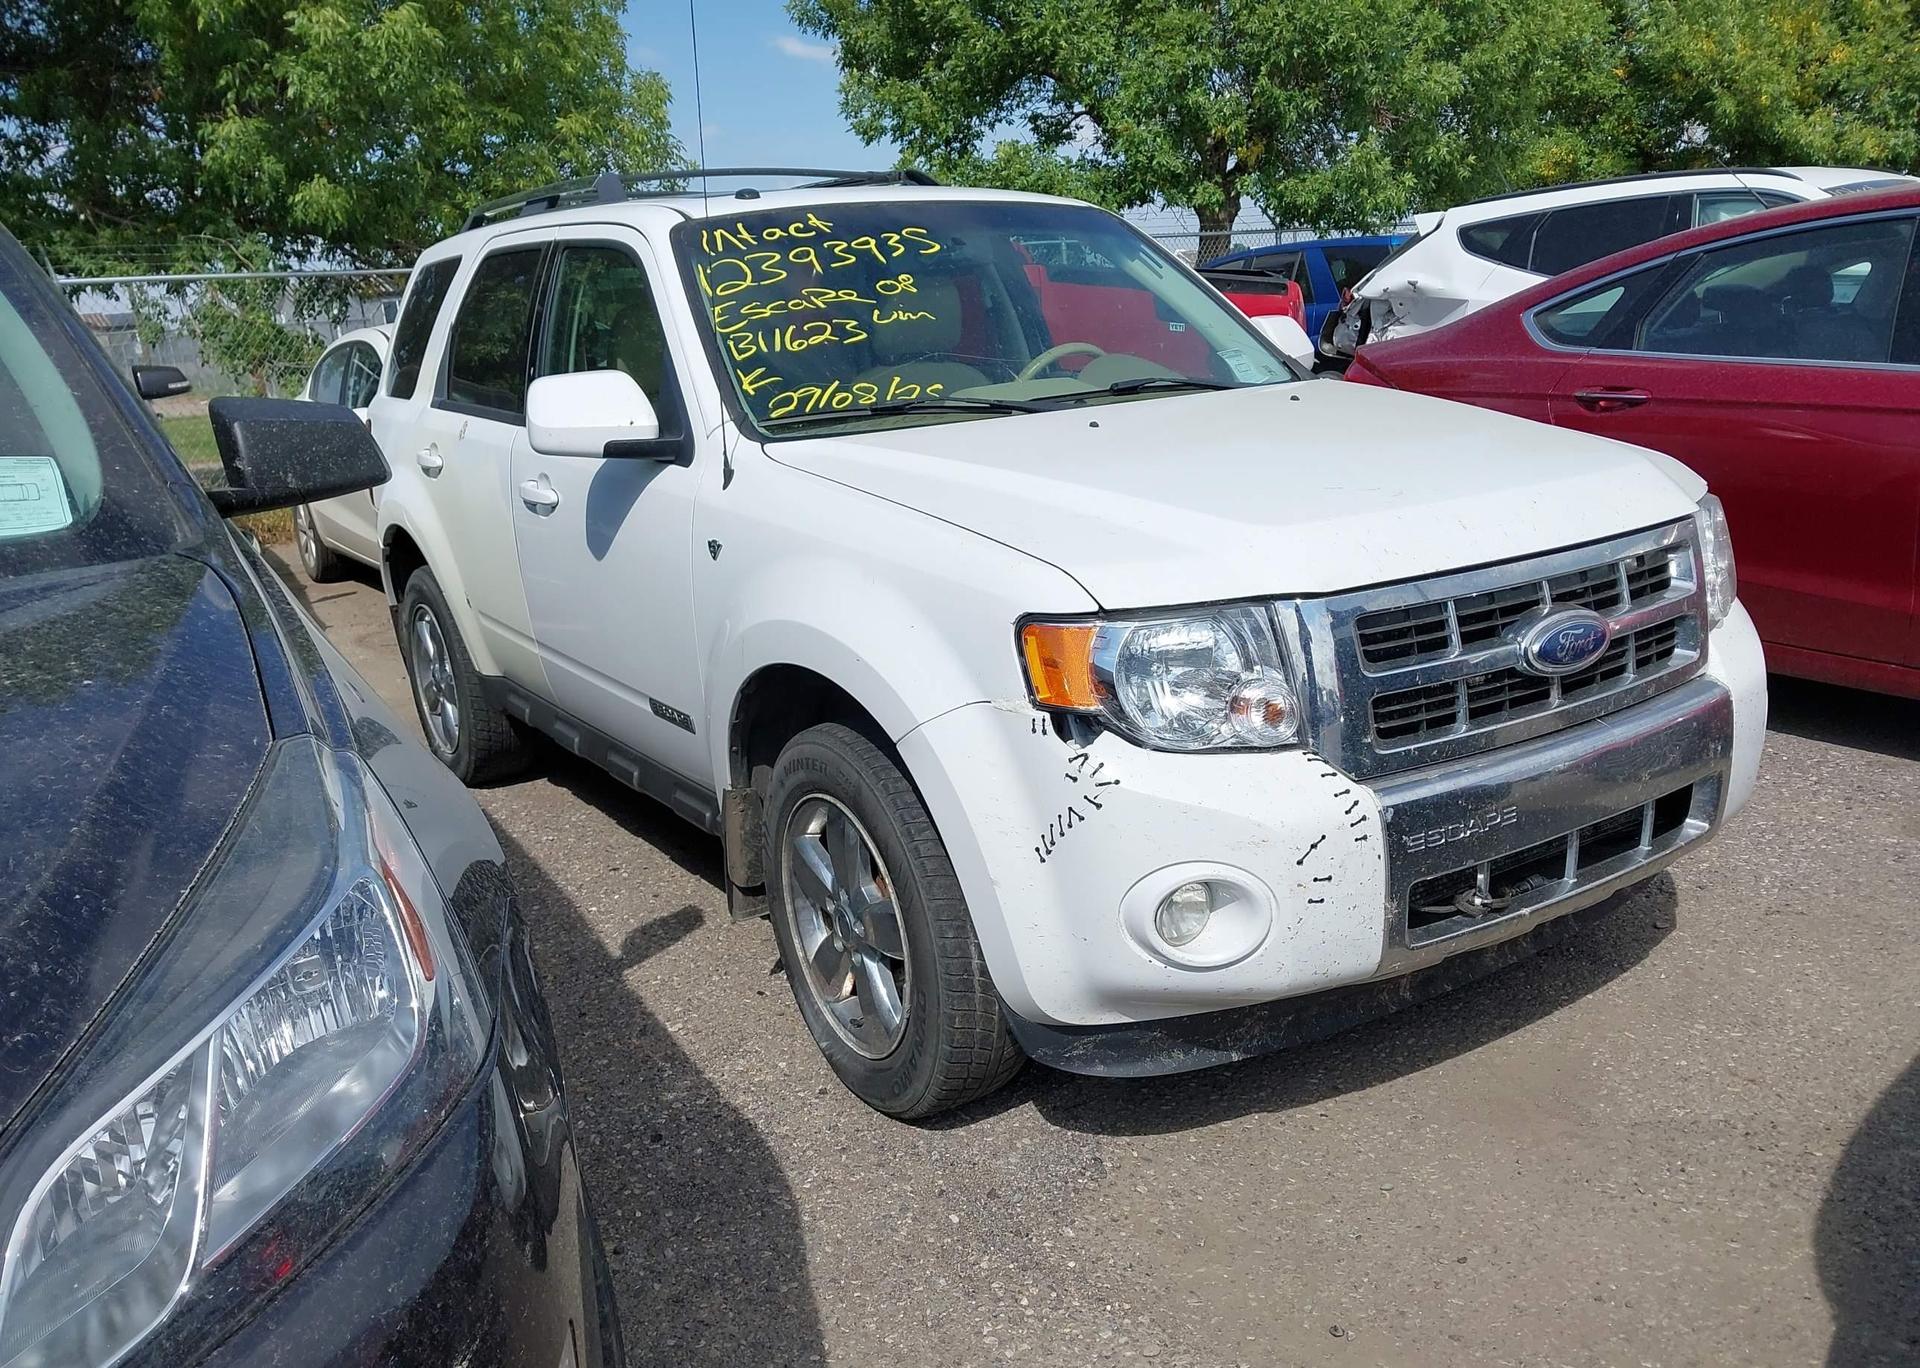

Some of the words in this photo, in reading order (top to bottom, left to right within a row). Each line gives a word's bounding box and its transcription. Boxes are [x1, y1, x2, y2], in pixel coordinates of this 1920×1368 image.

[698, 228, 942, 297] 12393935
[727, 319, 869, 361] B11623
[1557, 628, 1597, 662] Ford
[783, 757, 829, 777] WINTER
[1407, 806, 1518, 853] ESCAPE
